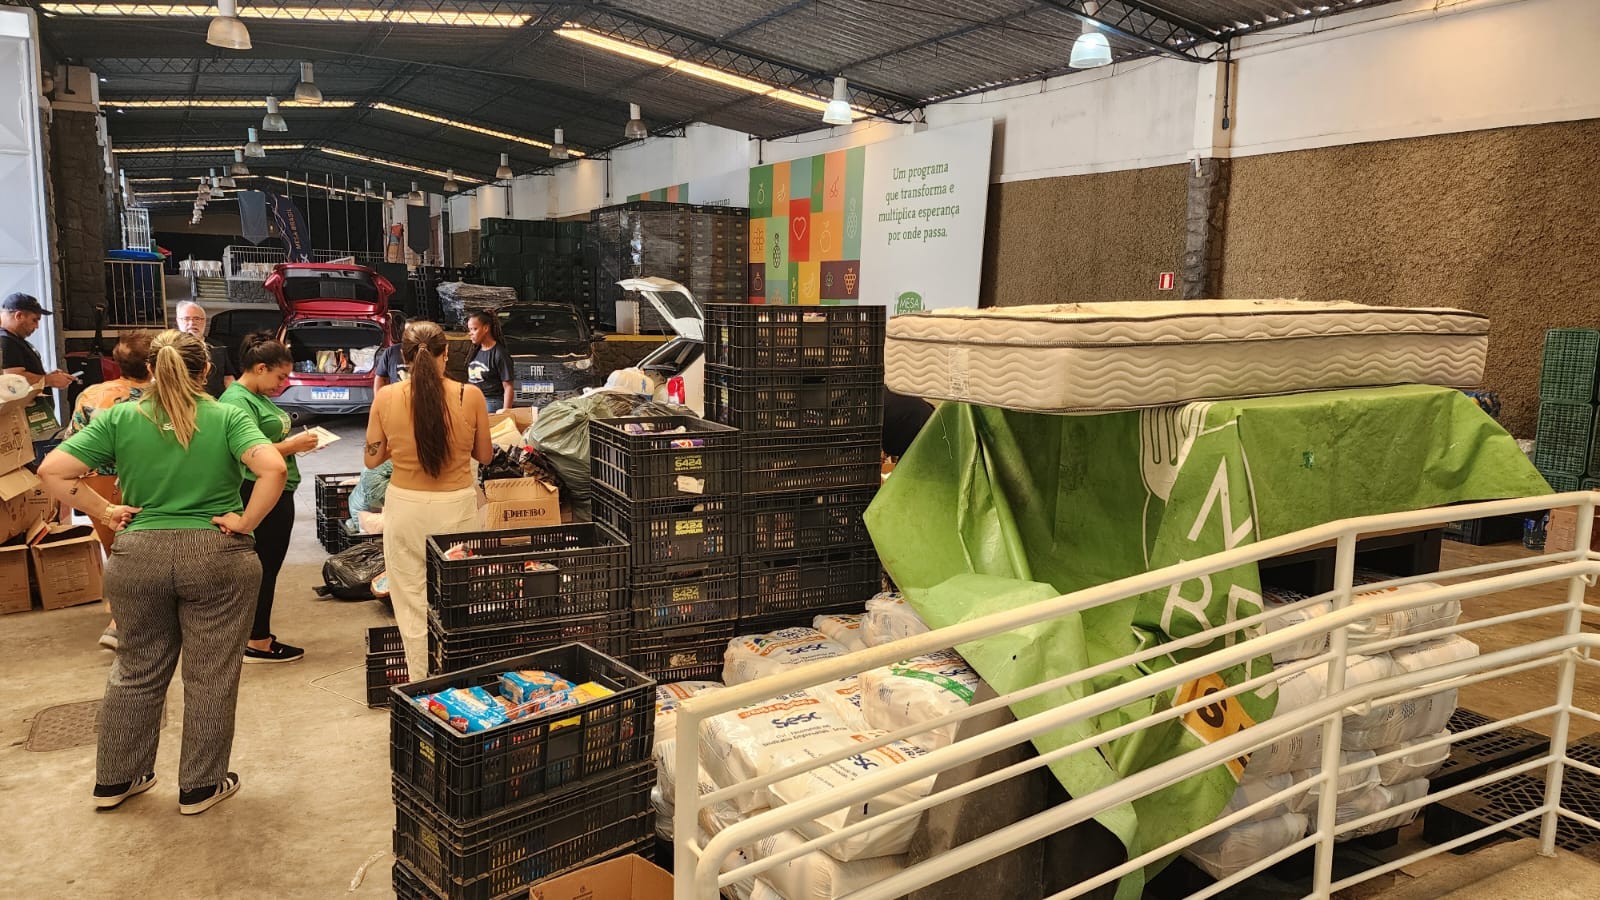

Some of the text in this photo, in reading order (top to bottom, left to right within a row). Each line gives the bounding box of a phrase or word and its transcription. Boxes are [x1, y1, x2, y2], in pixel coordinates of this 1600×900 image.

[892, 162, 949, 182] Um programa
[885, 183, 955, 206] que transforma e
[878, 204, 960, 225] multiplica esperança
[887, 226, 948, 246] por onde passa.
[530, 365, 545, 377] FIAT
[674, 458, 703, 468] 6424
[503, 507, 546, 522] PHEBO
[675, 522, 703, 533] 6424
[672, 588, 699, 600] 6424
